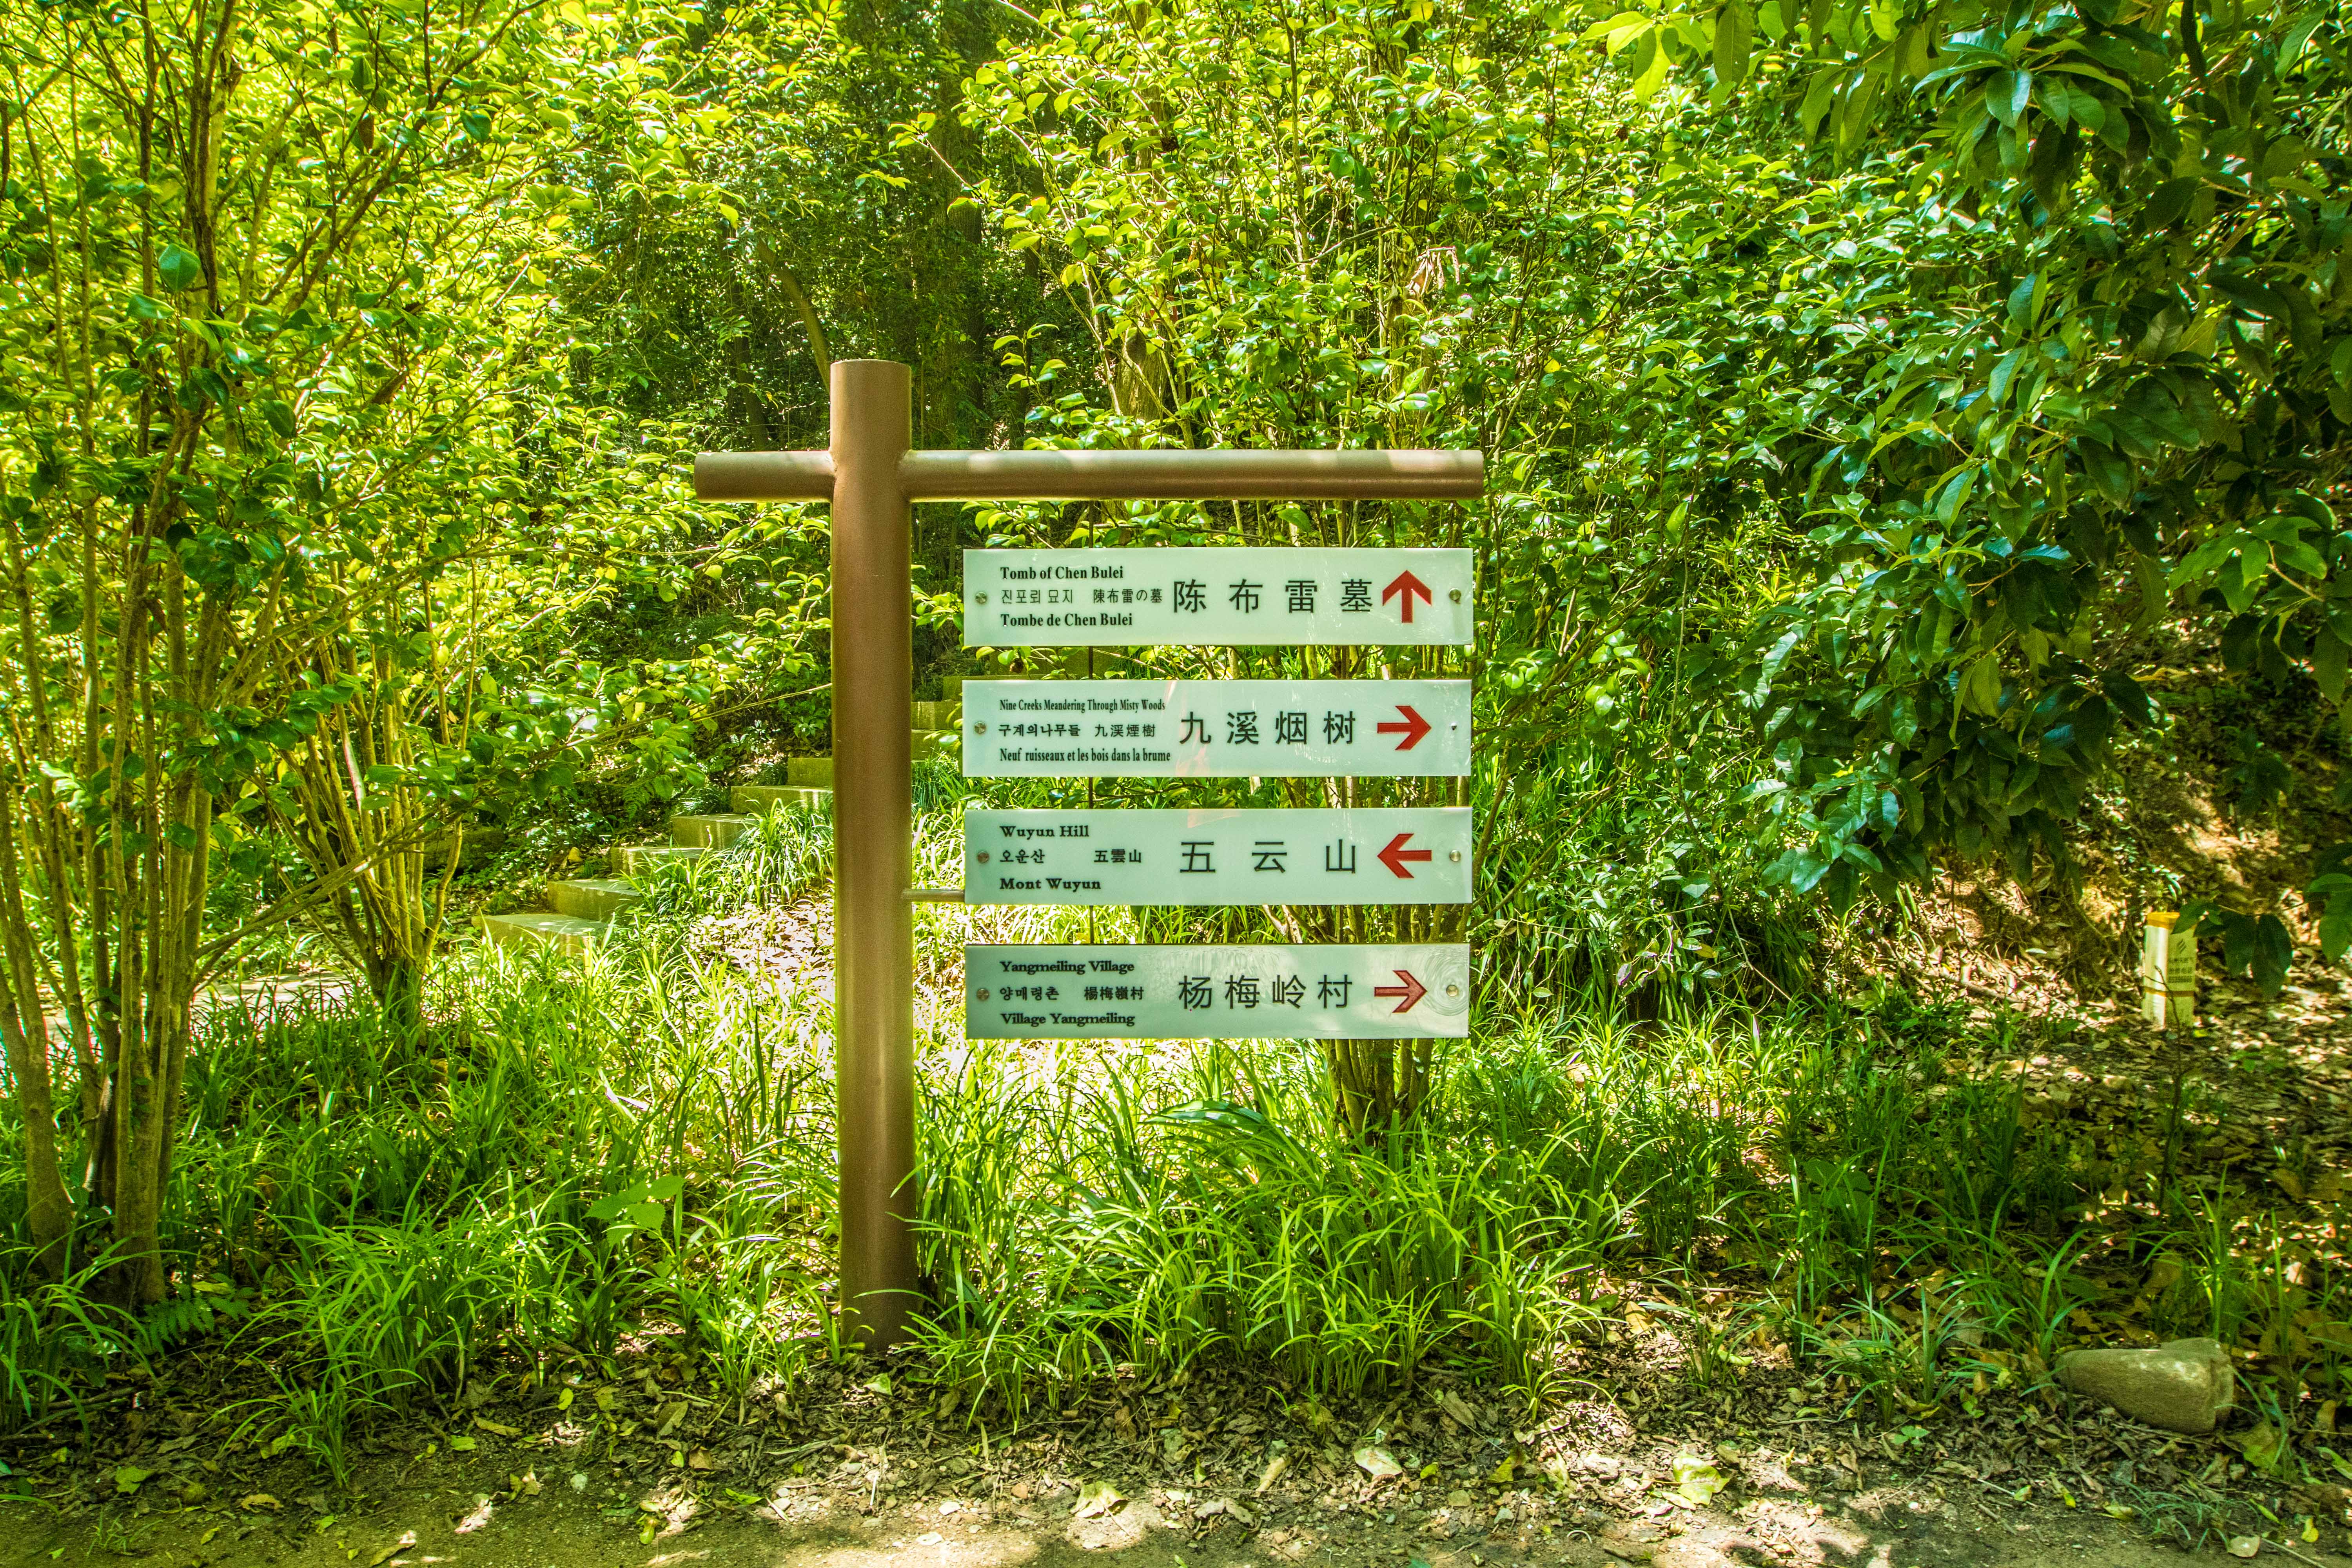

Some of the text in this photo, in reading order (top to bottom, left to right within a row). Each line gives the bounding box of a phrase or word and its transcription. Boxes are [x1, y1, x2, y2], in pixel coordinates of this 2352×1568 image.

[1000, 565, 1123, 579] Tomb of Chen Bulei
[1047, 589, 1073, 604] 묘지
[1093, 588, 1163, 604] 陳布雷の墓
[1174, 578, 1374, 613] 陈布雷墓
[1000, 612, 1132, 626] Tombe de Chen Bulei
[1000, 699, 1165, 714] Nine Creeks Meandering Through Misty Woods
[998, 724, 1081, 737] 구계의나무들
[1179, 711, 1356, 745] 九溪烟树
[1000, 747, 1171, 762] Neuf ruisseaux et les bois dans la brume
[999, 825, 1089, 840] Wuyun Hill
[999, 849, 1045, 864] 오운산
[1094, 848, 1142, 863] 五雲山
[1180, 839, 1356, 874] 五云山
[999, 878, 1101, 893] Mont Wuyun
[1000, 960, 1135, 975] Yangmeiling Village
[1000, 986, 1060, 1001] 양매령촌
[1083, 986, 1144, 1001] 楊梅嶺村
[1178, 974, 1353, 1010] 杨梅岭村
[1000, 1012, 1136, 1027] Village Yangmeiling
